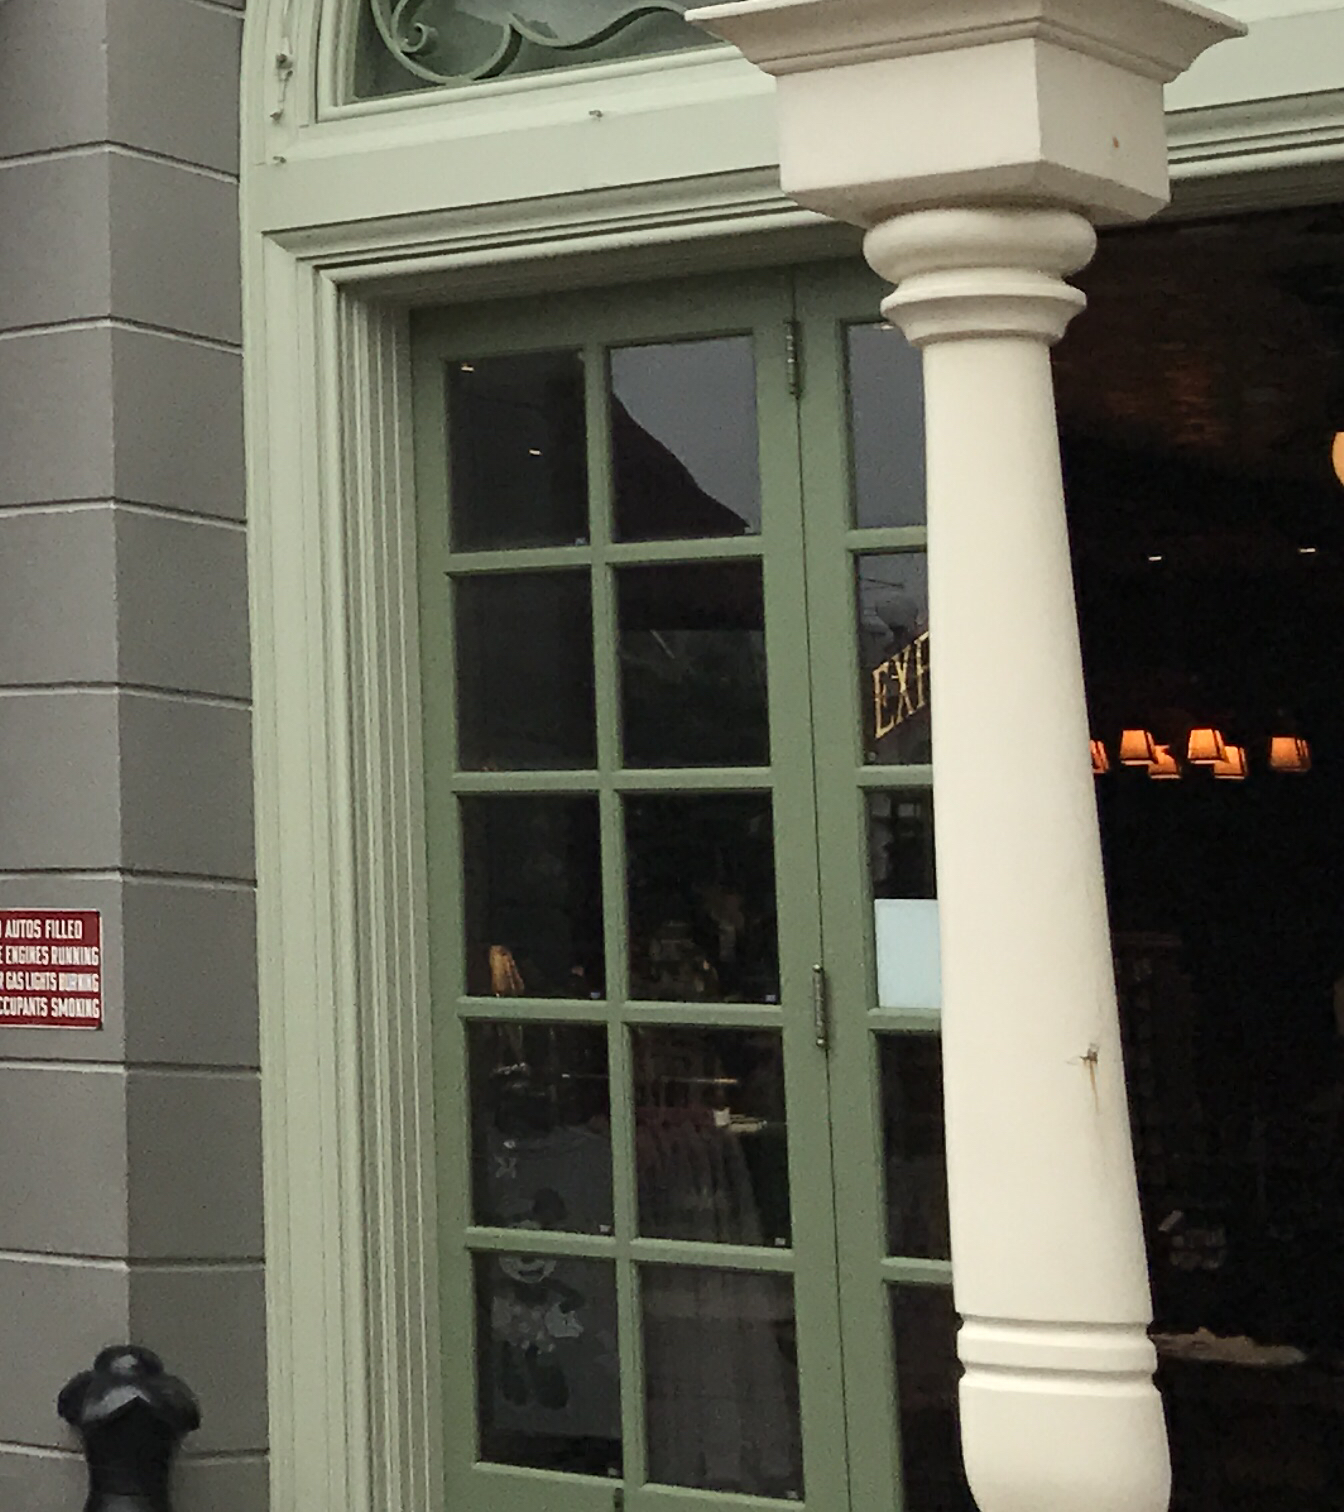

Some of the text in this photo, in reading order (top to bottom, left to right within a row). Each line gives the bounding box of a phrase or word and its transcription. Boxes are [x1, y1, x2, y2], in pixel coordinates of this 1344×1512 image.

[5, 919, 42, 939] AUTOS
[45, 919, 83, 939] FILLED
[6, 945, 49, 965] ENGINES
[51, 946, 99, 966] RUNNING
[6, 971, 24, 991] GAS
[25, 971, 57, 991] LIGHTS
[51, 997, 100, 1018] SMOKING
